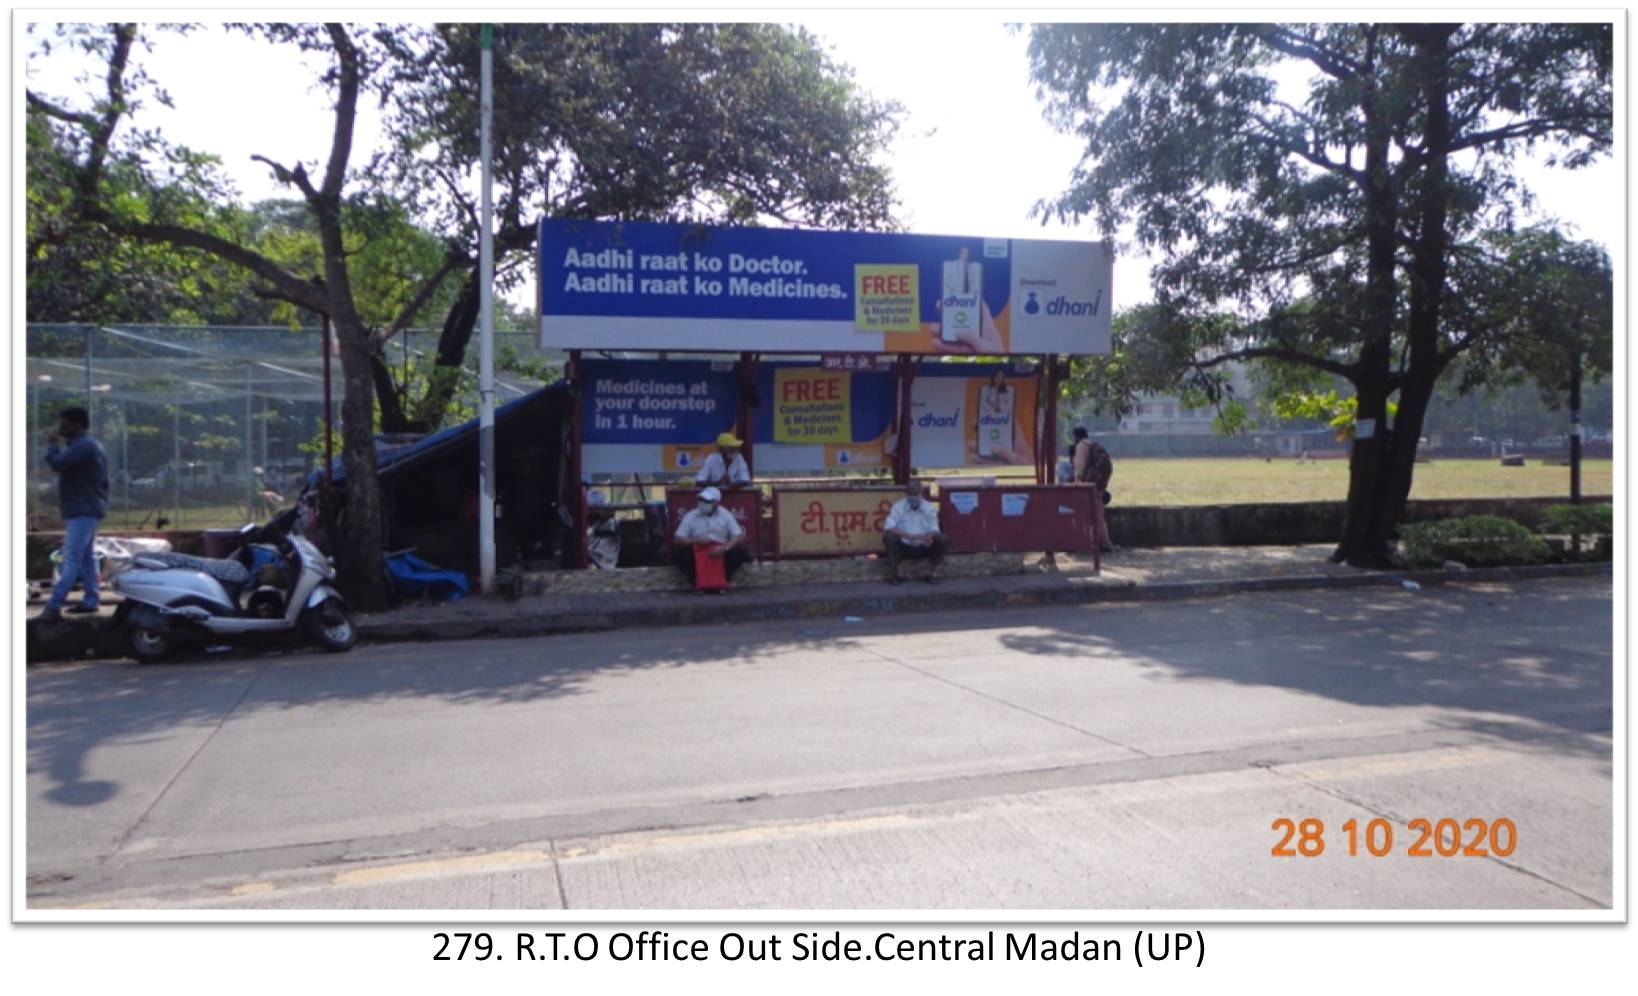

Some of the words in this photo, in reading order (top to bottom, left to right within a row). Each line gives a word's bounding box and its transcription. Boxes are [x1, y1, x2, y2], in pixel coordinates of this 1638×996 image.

[564, 247, 634, 269] Aadhi
[640, 252, 688, 271] raat
[694, 252, 723, 273] ko
[729, 254, 808, 275] Doctor.
[564, 272, 634, 294] Aadhi
[640, 277, 688, 295] raat
[694, 277, 723, 297] ko
[729, 278, 848, 300] Medicines.
[862, 275, 911, 295] FREE
[1046, 288, 1102, 316] dhani
[596, 379, 686, 395] Medicines
[690, 381, 708, 395] at
[783, 377, 840, 402] FREE
[595, 398, 634, 412] your
[638, 396, 716, 413] doorstep
[779, 402, 844, 415] Consultations
[595, 414, 612, 429] in
[616, 414, 628, 429] 1
[632, 413, 677, 430] hour.
[793, 414, 842, 425] Medicines
[918, 405, 960, 428] dhani
[787, 426, 800, 436] for
[803, 425, 815, 436] 30
[817, 423, 839, 436] days
